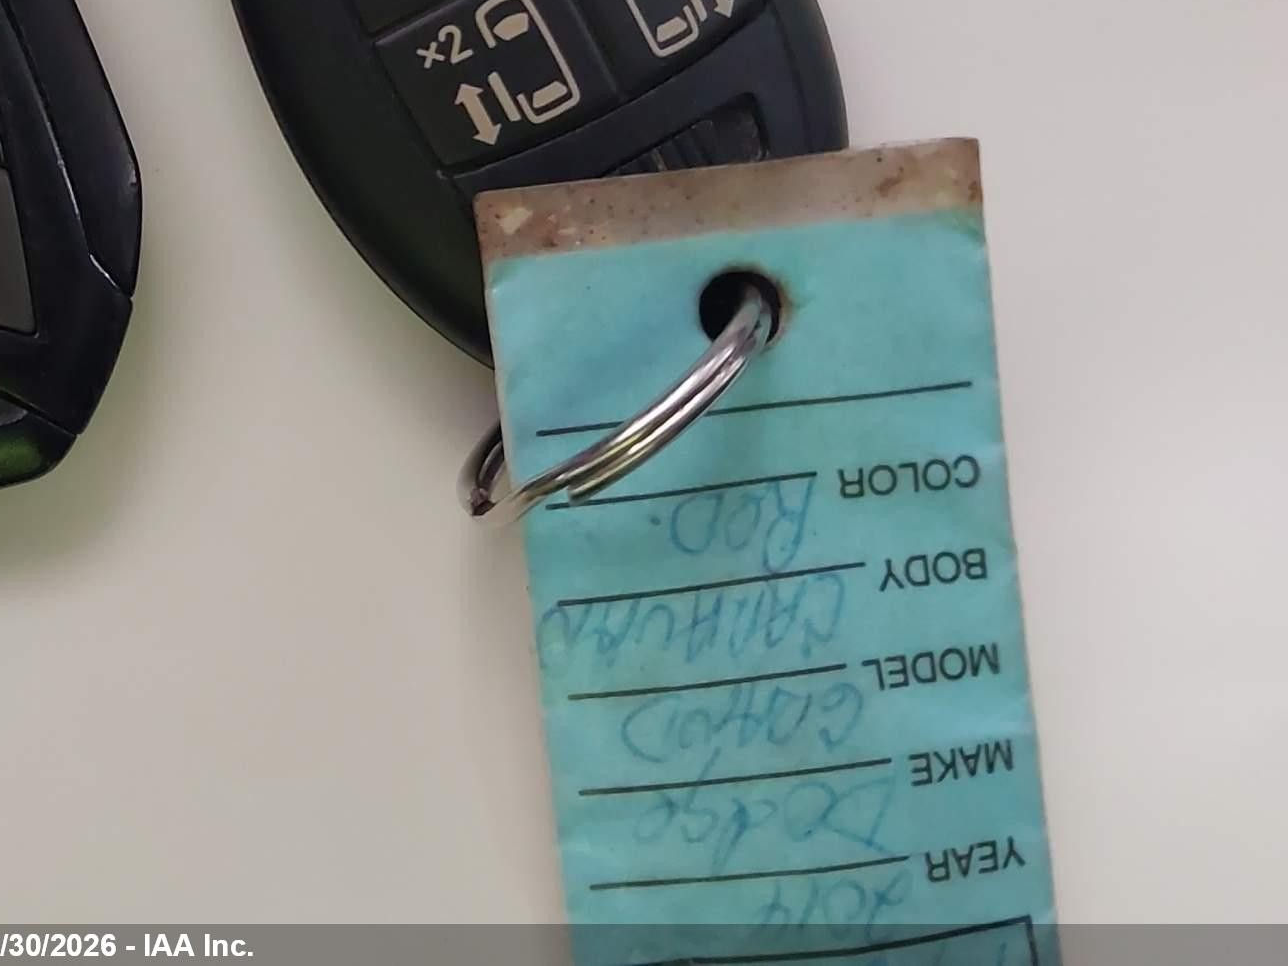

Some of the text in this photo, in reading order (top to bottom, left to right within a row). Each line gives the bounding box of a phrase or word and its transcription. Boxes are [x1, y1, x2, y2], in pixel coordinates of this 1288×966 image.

[840, 454, 982, 499] COLOR
[878, 548, 988, 591] BODY
[862, 642, 1001, 691] MODEL
[909, 739, 1014, 786] MAKE
[924, 836, 1027, 883] YEAR
